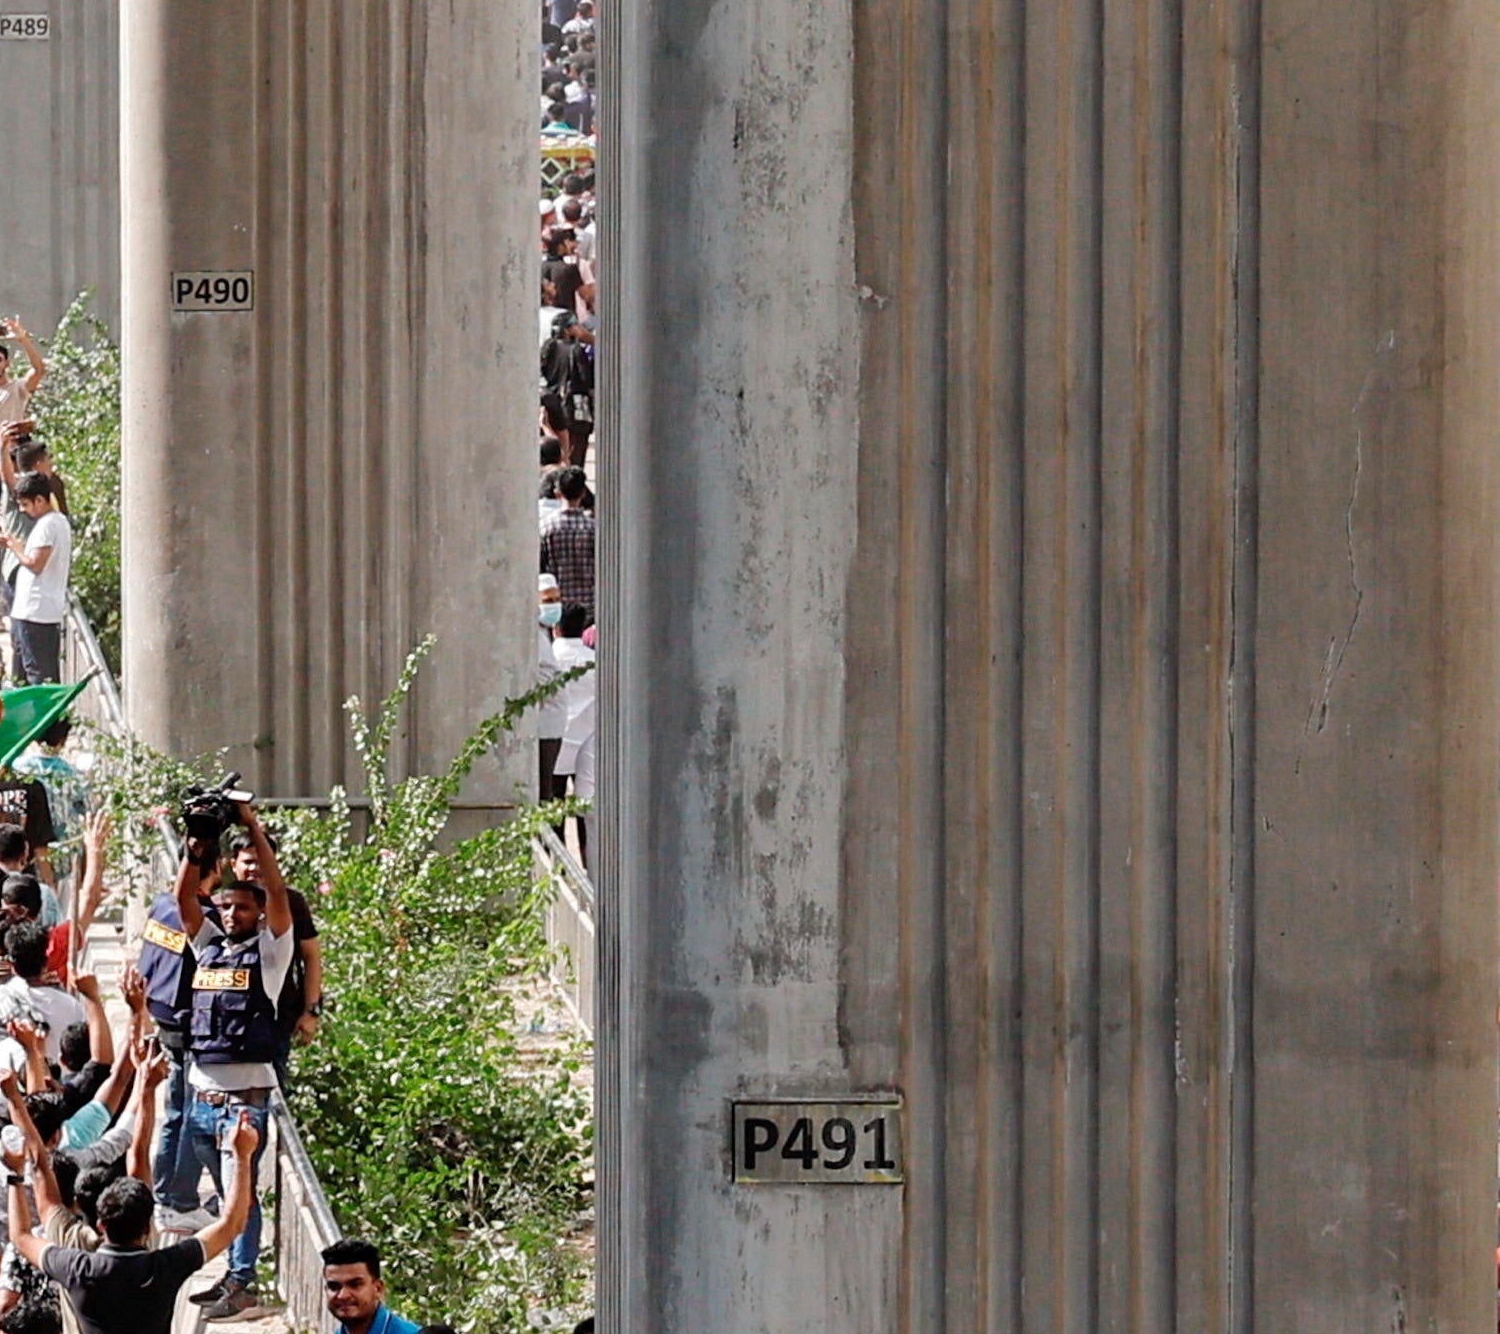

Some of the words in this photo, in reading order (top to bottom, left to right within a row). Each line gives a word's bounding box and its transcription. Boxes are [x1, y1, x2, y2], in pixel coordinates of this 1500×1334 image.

[0, 18, 49, 37] P489
[176, 277, 250, 306] P490
[193, 971, 247, 988] PRESS
[743, 1116, 896, 1170] P491
